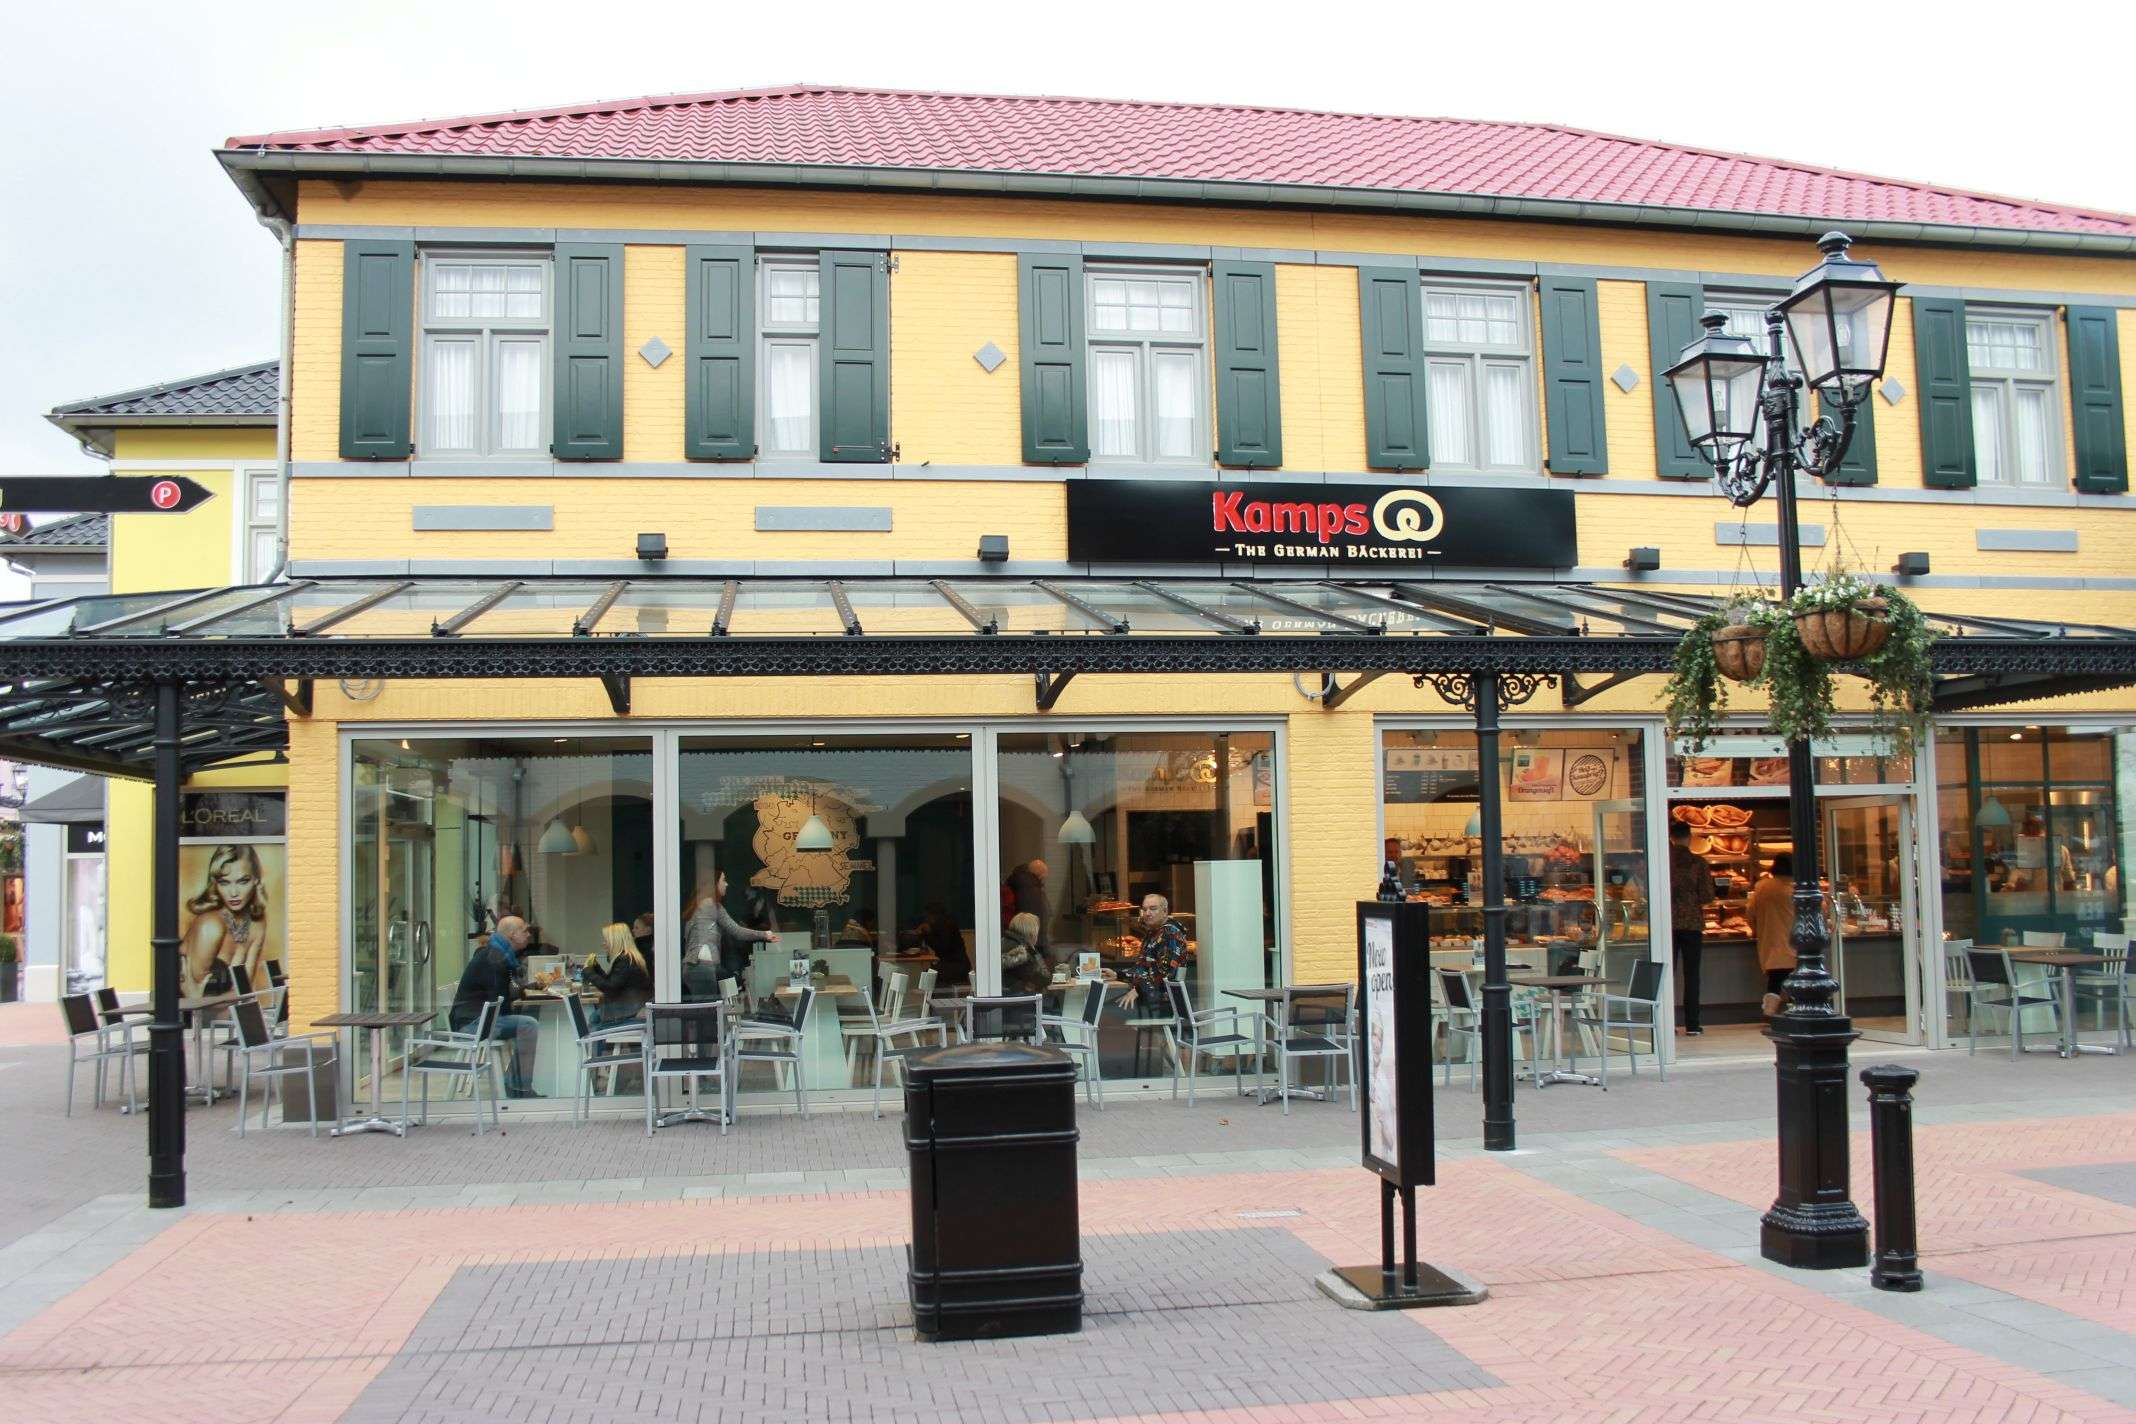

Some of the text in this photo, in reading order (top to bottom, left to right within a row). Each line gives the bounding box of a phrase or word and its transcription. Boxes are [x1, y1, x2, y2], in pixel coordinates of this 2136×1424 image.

[1212, 491, 1370, 544] Kamps
[1274, 544, 1340, 558] GERMAN
[87, 831, 106, 844] M
[1367, 941, 1386, 969] Now
[1371, 972, 1393, 1000] open
